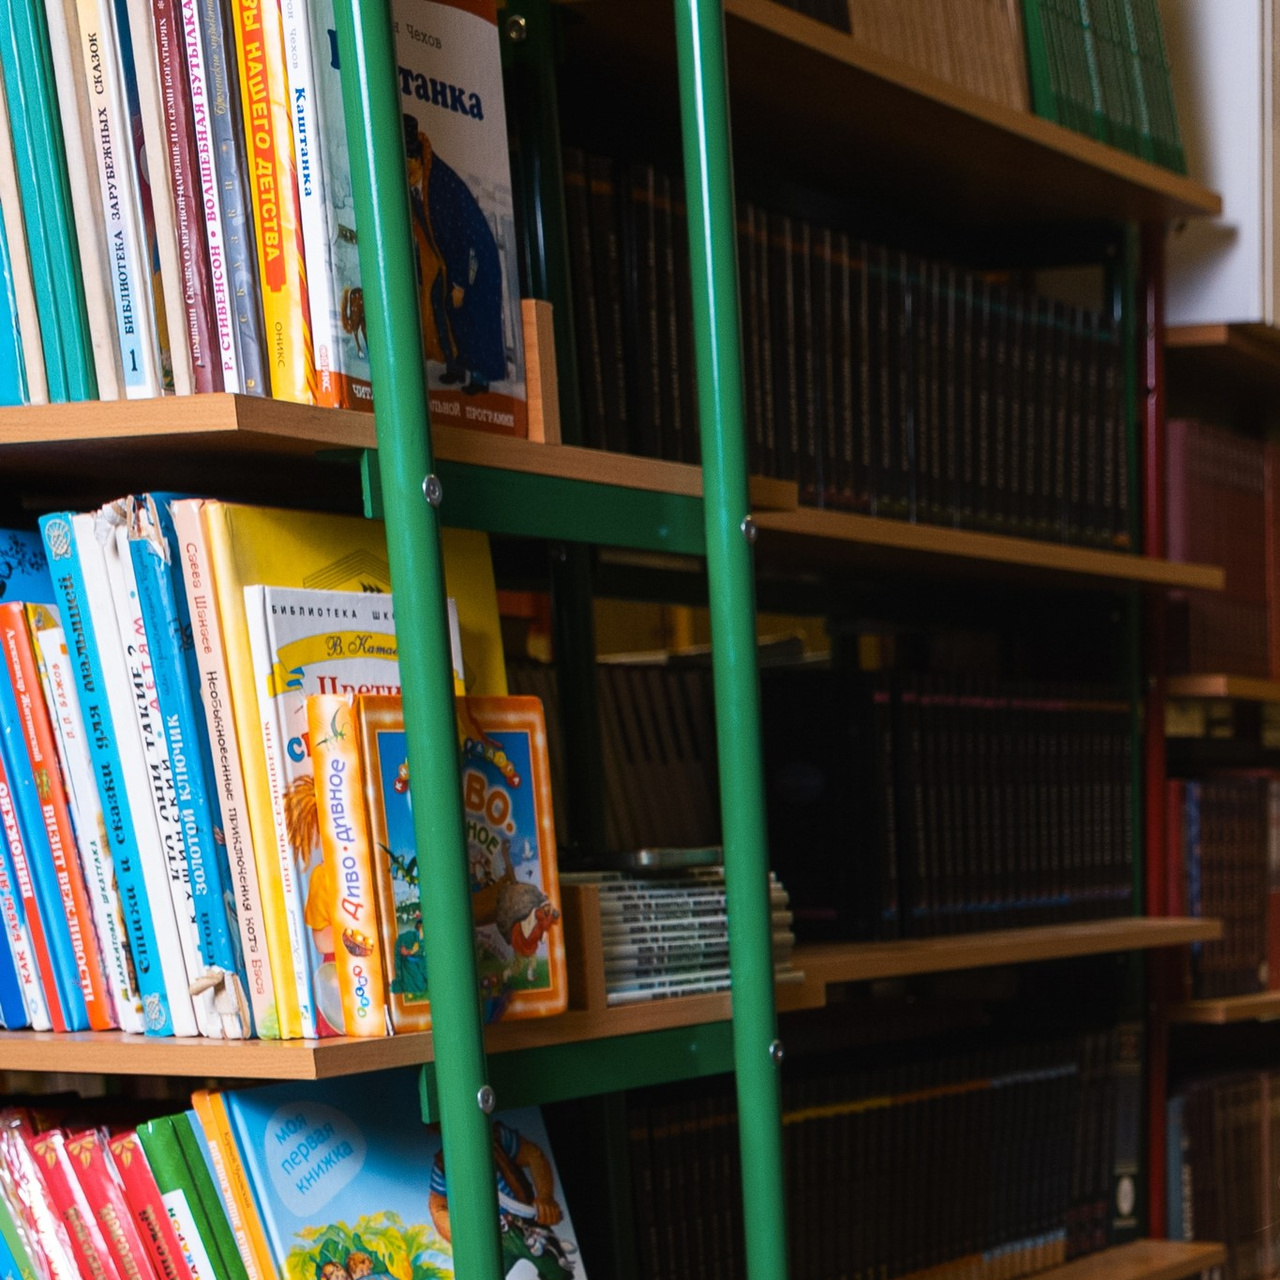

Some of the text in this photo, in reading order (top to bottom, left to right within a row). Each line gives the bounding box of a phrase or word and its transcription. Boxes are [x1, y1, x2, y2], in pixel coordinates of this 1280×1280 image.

[156, 18, 173, 86] БОГАТЫРЯХ
[406, 24, 443, 49] Чехов
[165, 88, 177, 119] СЕМИ
[243, 42, 273, 149] НАШЕГО
[295, 87, 312, 197] Каштанка
[88, 32, 138, 372] 1 БИБЛИОТЕКА ЗАРУБЕЖНЫХ СКАЗОК
[182, 0, 234, 371] Р. СТИВЕНСОН ВОЛШЕБНАЯ БУТЫЛКА
[255, 156, 283, 261] ДЕТСТВА
[274, 322, 285, 367] ОНИКС
[271, 605, 358, 620] БИБЛИОТЕКА
[325, 634, 398, 657] В. Ката
[1, 627, 30, 692] Александр
[46, 662, 72, 708] БАЖОВ
[129, 617, 164, 713] ДЕТЯМ
[57, 573, 151, 974] Стихи и сказки для малышей
[165, 713, 193, 800] КЛЮЧИК
[183, 541, 266, 995] Савва Шанаев Необыкновенные приключения кота Баса
[260, 721, 295, 893] ЦВЕТИК-СЕМИЦВЕТИК
[322, 757, 365, 922] Диво дивное
[88, 840, 111, 904] ШКАТУЛКА
[179, 807, 209, 896] ЗОЛОТОЙ
[3, 896, 22, 942] БАБЫ
[41, 803, 96, 1002] ВИЗИТ ВЕЖЛИВОСТИ
[16, 950, 32, 985] КАК
[274, 1113, 307, 1145] моя
[281, 1122, 335, 1175] первая
[295, 1141, 354, 1195] книжка
